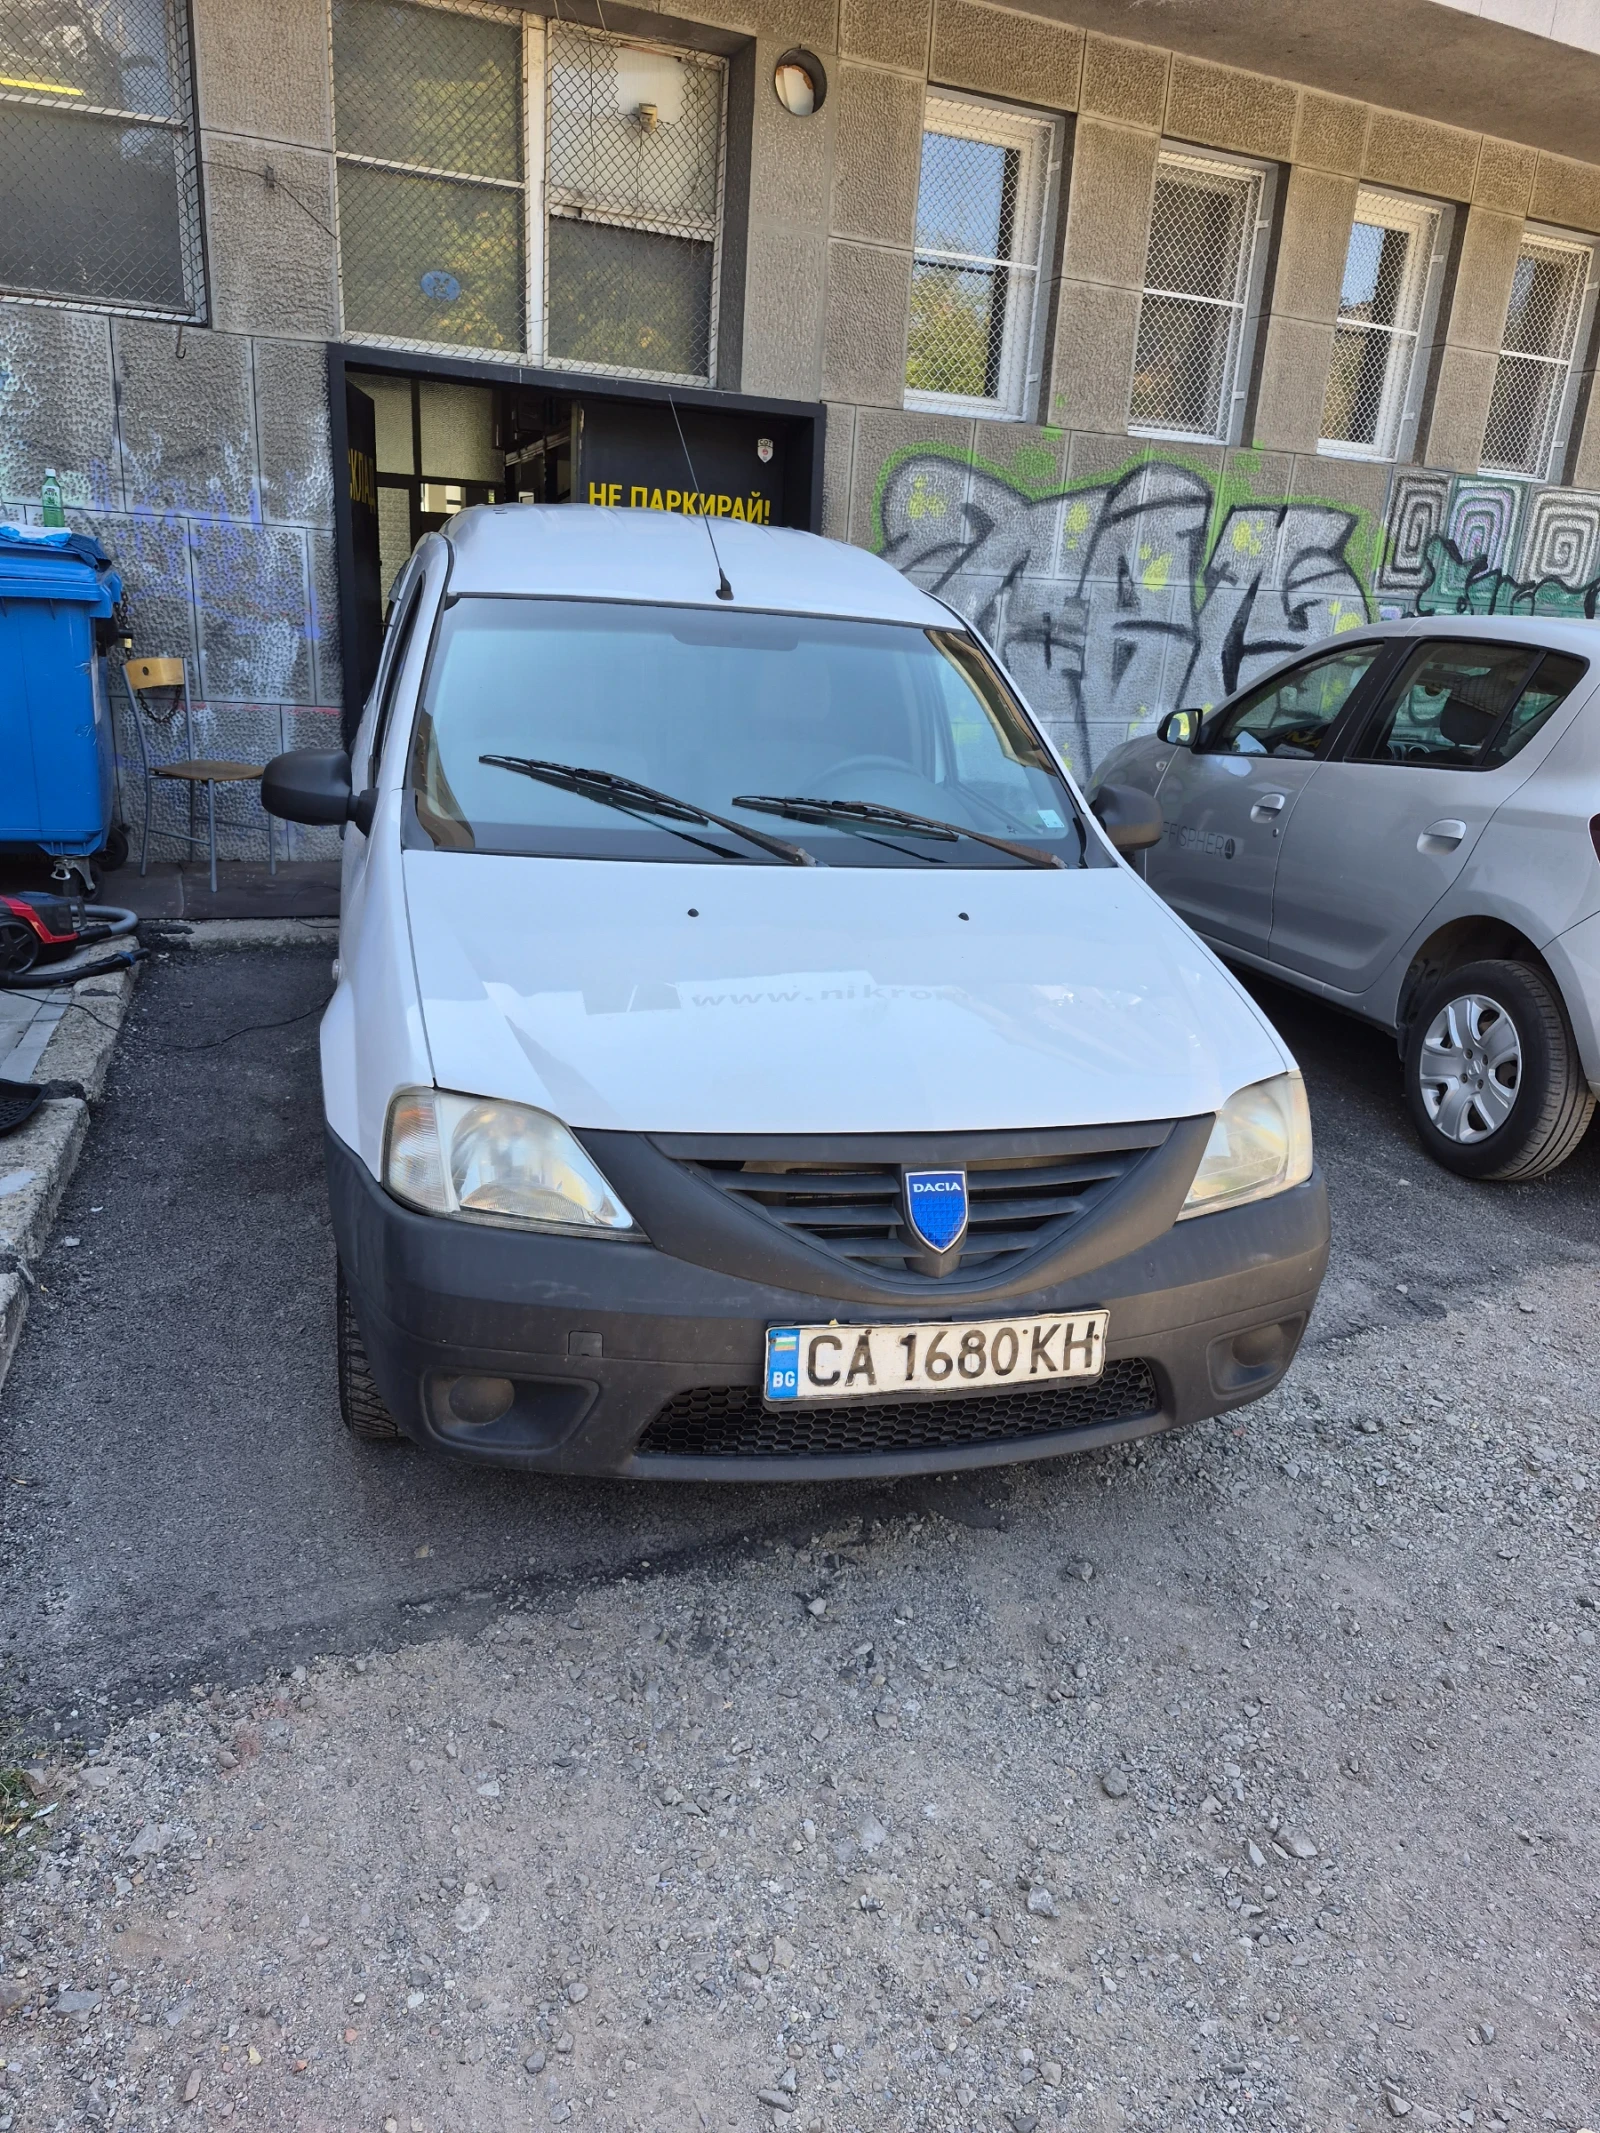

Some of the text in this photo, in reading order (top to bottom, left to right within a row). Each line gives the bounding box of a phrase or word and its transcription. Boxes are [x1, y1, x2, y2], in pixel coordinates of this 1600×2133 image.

[589, 482, 771, 525] НЕ ПАРКИРАЙ!
[912, 1182, 962, 1193] DACIA
[807, 1320, 1096, 1387] CA 1680 KH
[773, 1371, 795, 1388] BG
